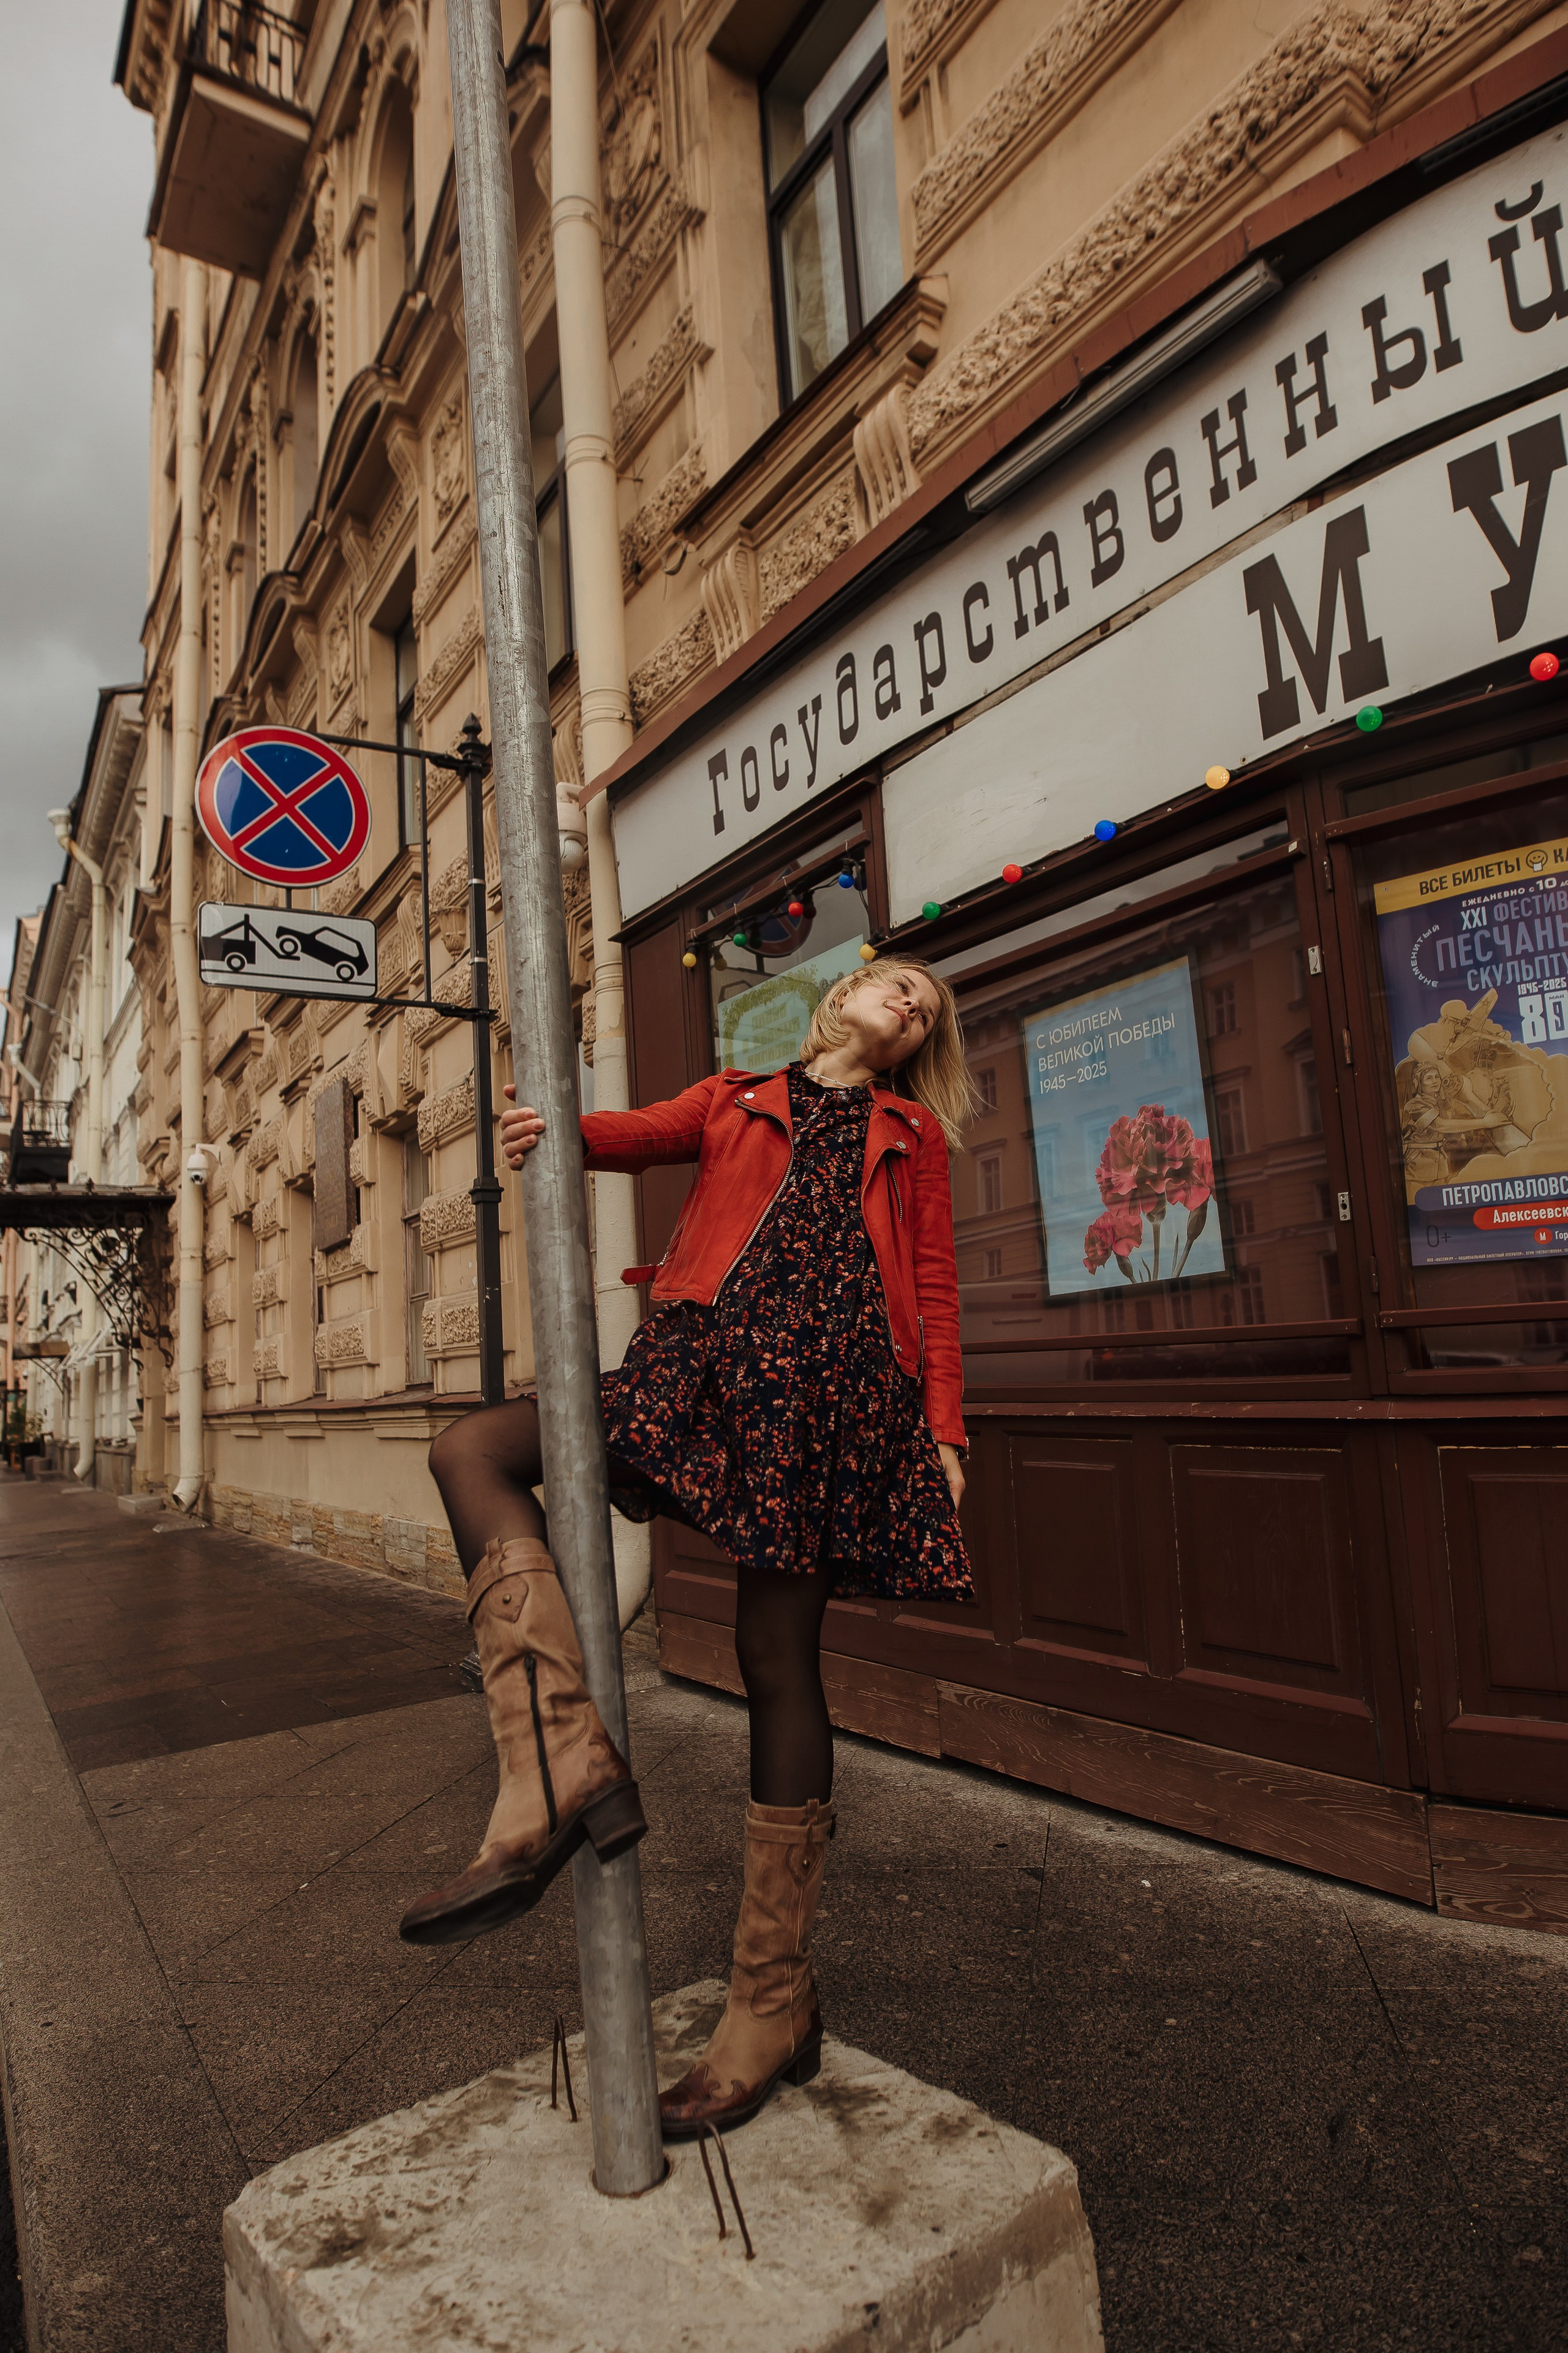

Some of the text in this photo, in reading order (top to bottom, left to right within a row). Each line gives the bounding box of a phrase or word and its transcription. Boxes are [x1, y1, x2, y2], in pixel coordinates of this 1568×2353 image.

[707, 180, 1568, 837] Государственный
[1419, 875, 1448, 896] ВСЕ
[1452, 857, 1521, 887] БИЛЕТЫ
[1461, 888, 1525, 908] ЕЖЕДНЕВНО
[1536, 877, 1557, 891] 10
[1461, 906, 1487, 931] XXI
[1411, 924, 1440, 988] ЗНАМЕНИТЫЙ
[1036, 1007, 1122, 1049] С ЮБИЛЕЕМ
[1038, 1013, 1176, 1073] ВЕЛИКОЙ ПОБЕДЫ
[1427, 1225, 1452, 1248] 0+
